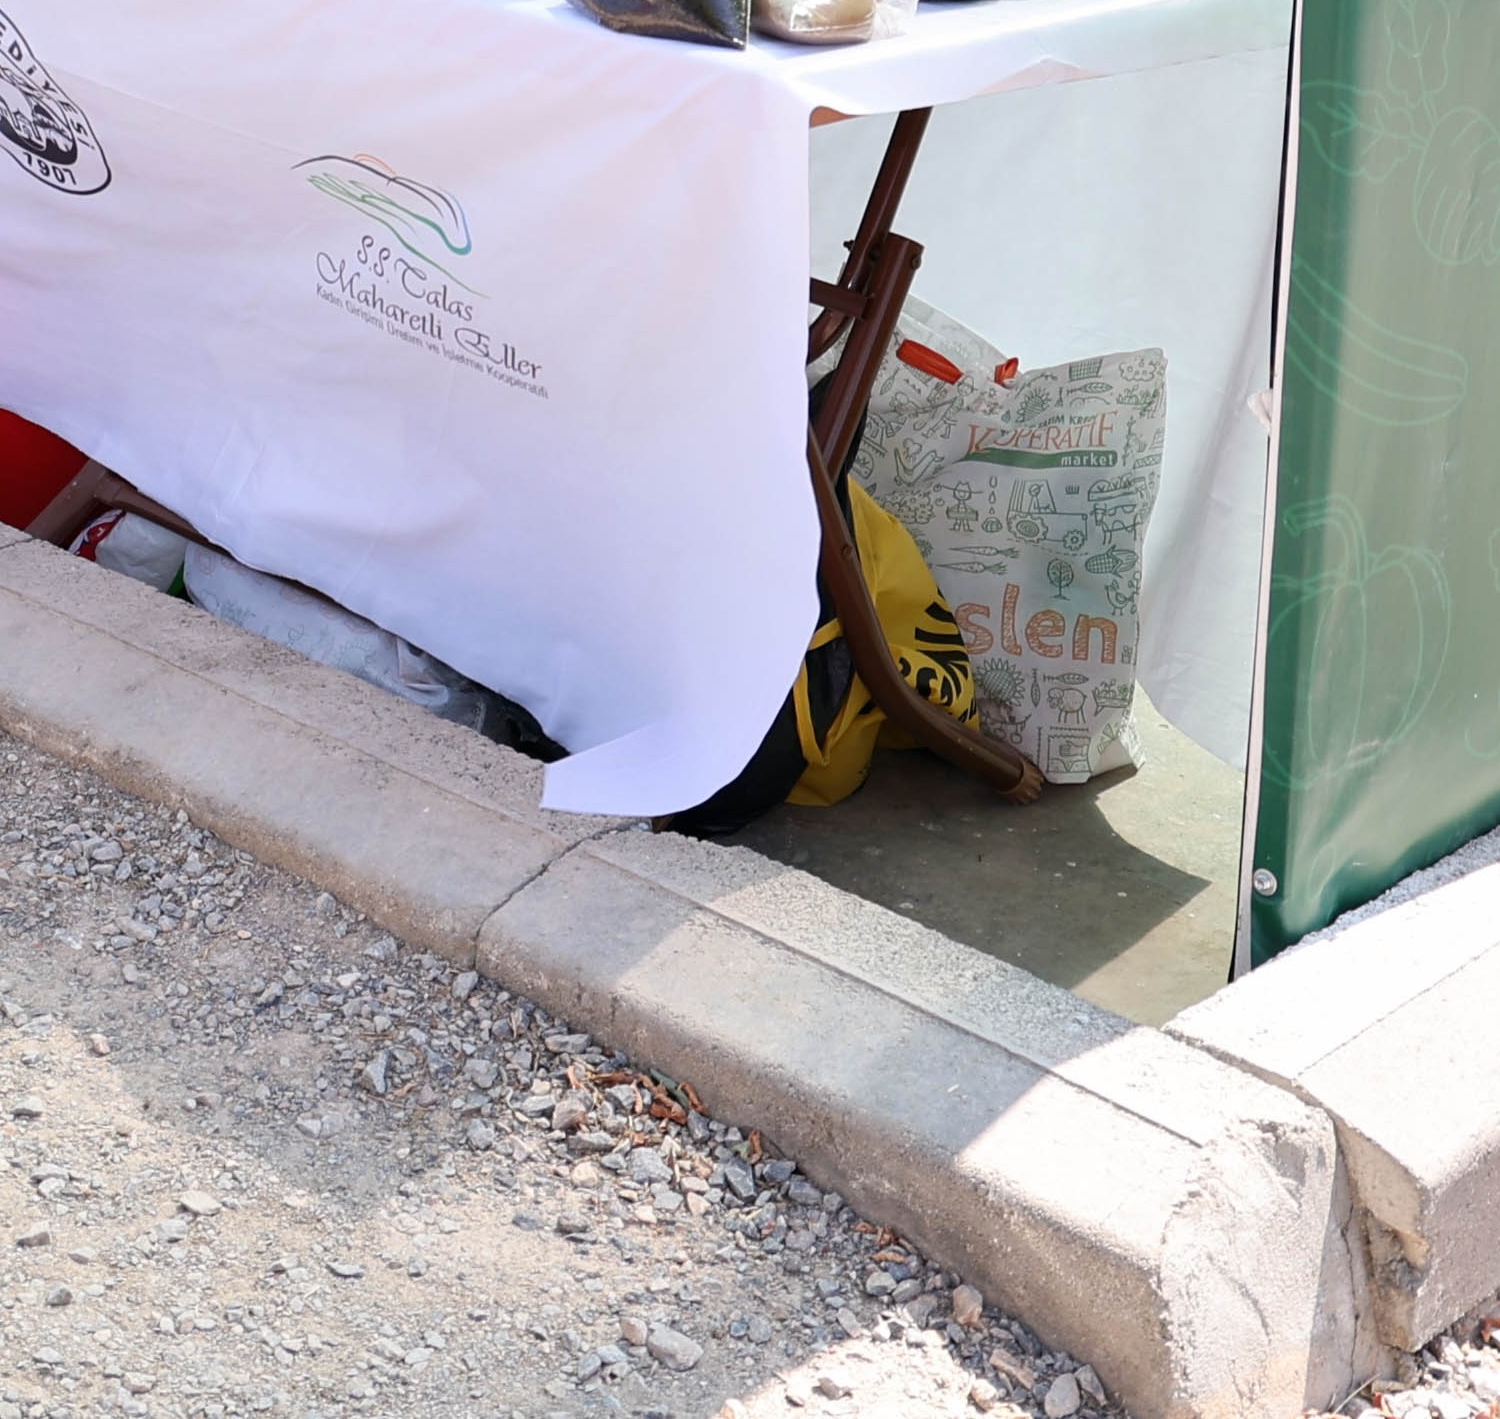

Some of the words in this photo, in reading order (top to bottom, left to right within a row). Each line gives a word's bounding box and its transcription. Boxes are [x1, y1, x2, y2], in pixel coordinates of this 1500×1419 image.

[22, 151, 77, 186] 1907
[394, 257, 474, 322] Talas
[316, 251, 443, 341] Maharetli
[454, 327, 543, 380] Eller
[1060, 453, 1115, 468] market
